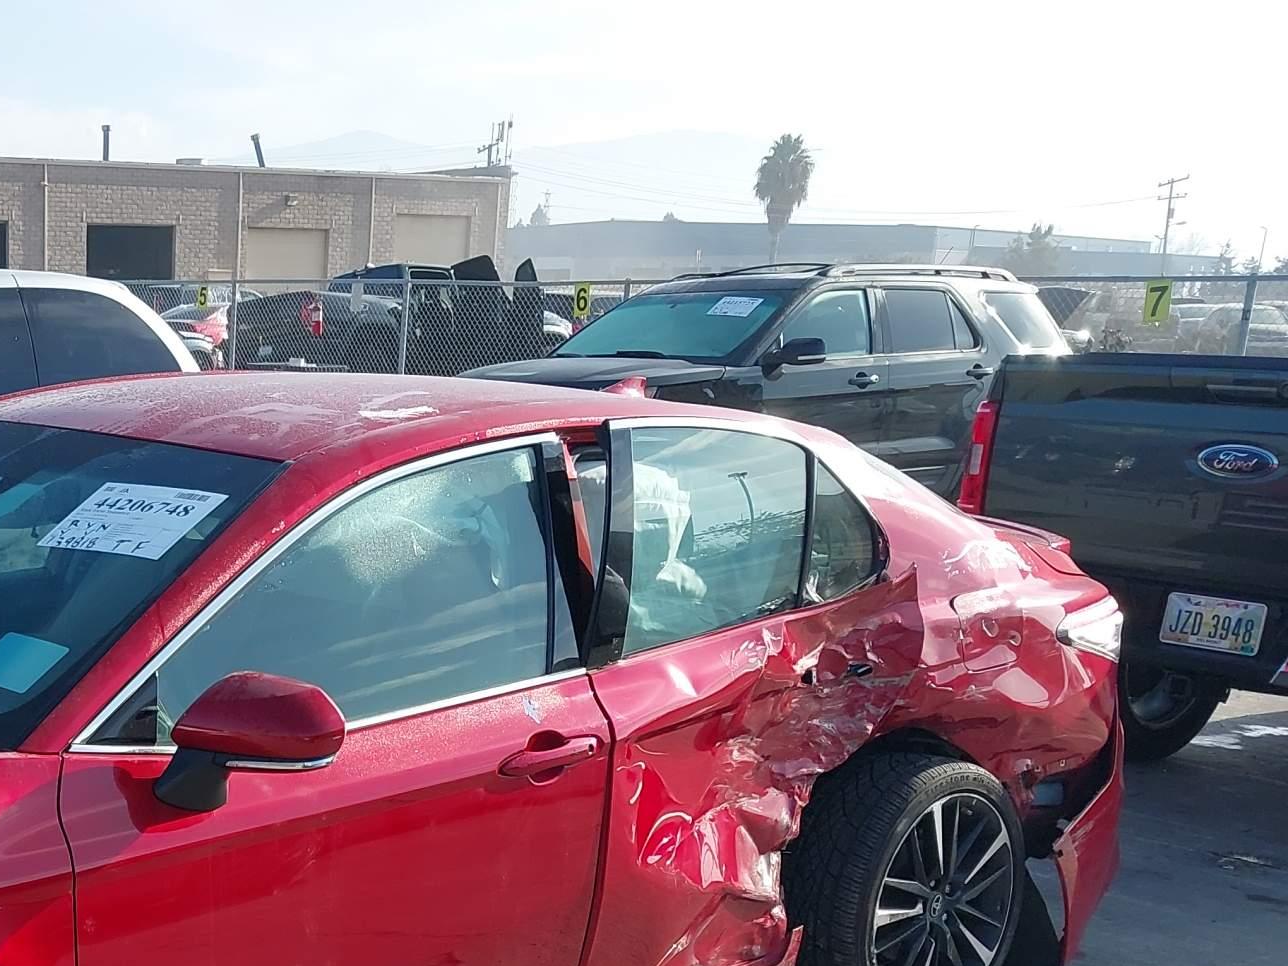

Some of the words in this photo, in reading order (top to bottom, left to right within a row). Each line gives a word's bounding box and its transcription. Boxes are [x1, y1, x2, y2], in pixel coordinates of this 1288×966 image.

[199, 286, 207, 306] 5
[576, 287, 588, 312] 6
[1149, 285, 1169, 318] 7
[1213, 450, 1258, 471] Ford
[93, 496, 196, 518] 44206748
[1169, 609, 1204, 636] JZD
[1207, 614, 1255, 644] 3948
